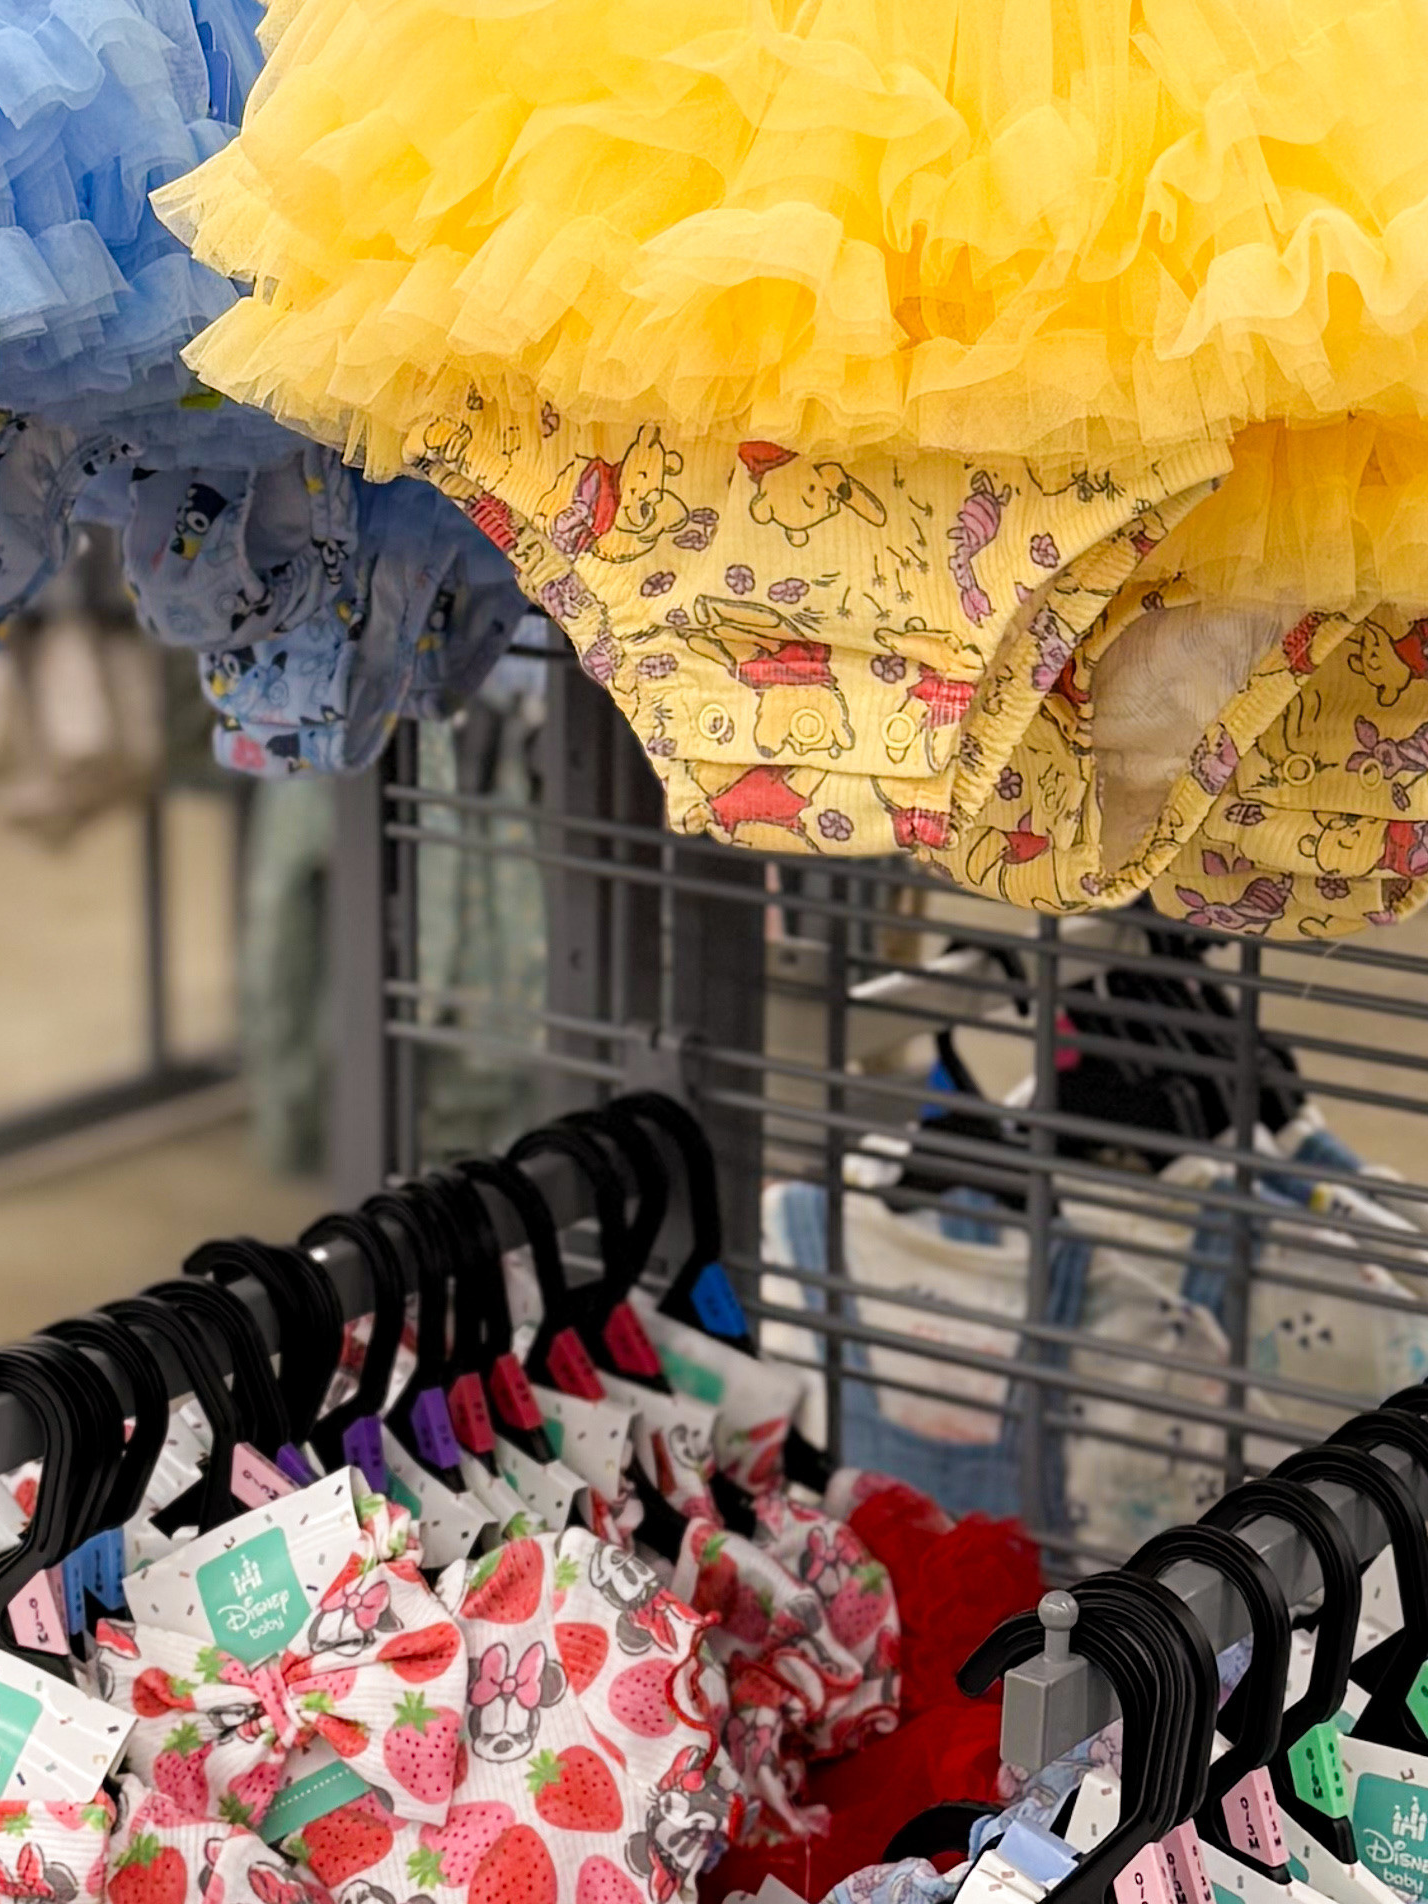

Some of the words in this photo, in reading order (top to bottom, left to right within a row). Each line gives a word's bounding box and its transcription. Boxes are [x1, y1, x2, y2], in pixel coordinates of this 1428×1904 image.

[216, 1590, 290, 1632] Disney
[248, 1614, 285, 1640] baby
[1383, 1867, 1425, 1893] baby
